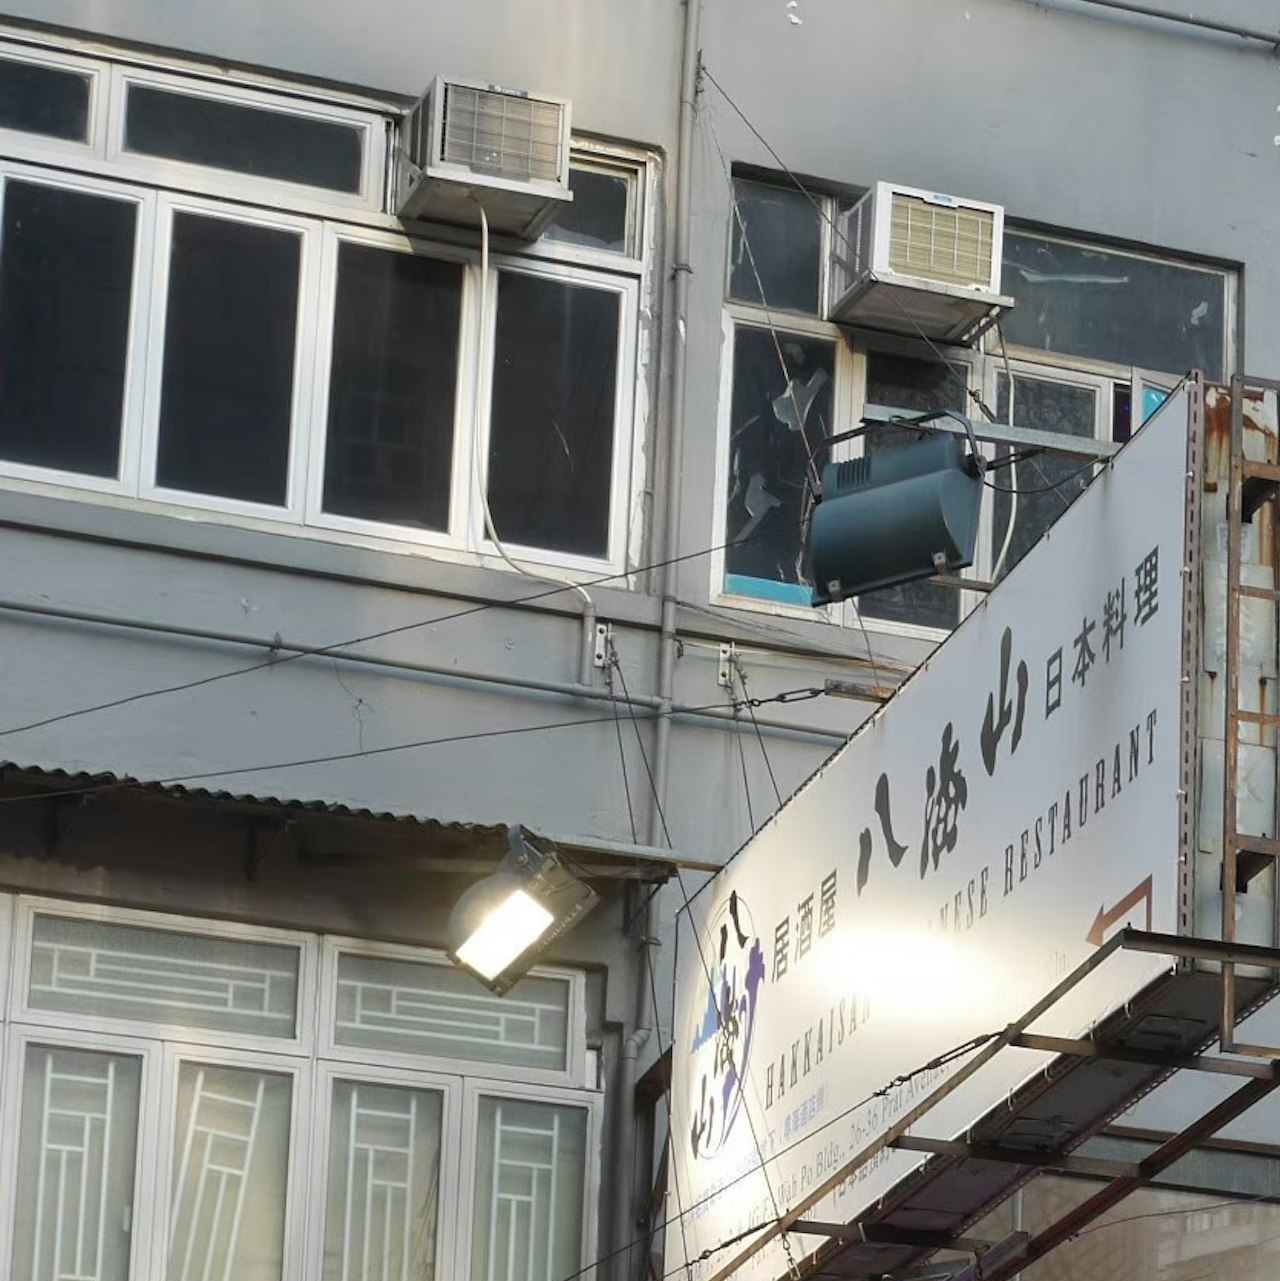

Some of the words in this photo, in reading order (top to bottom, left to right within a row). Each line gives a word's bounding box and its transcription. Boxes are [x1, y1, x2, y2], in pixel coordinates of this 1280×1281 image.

[771, 868, 840, 985] 居酒屋
[1043, 544, 1162, 720] 日本料理
[1003, 707, 1158, 898] RESTAURANT
